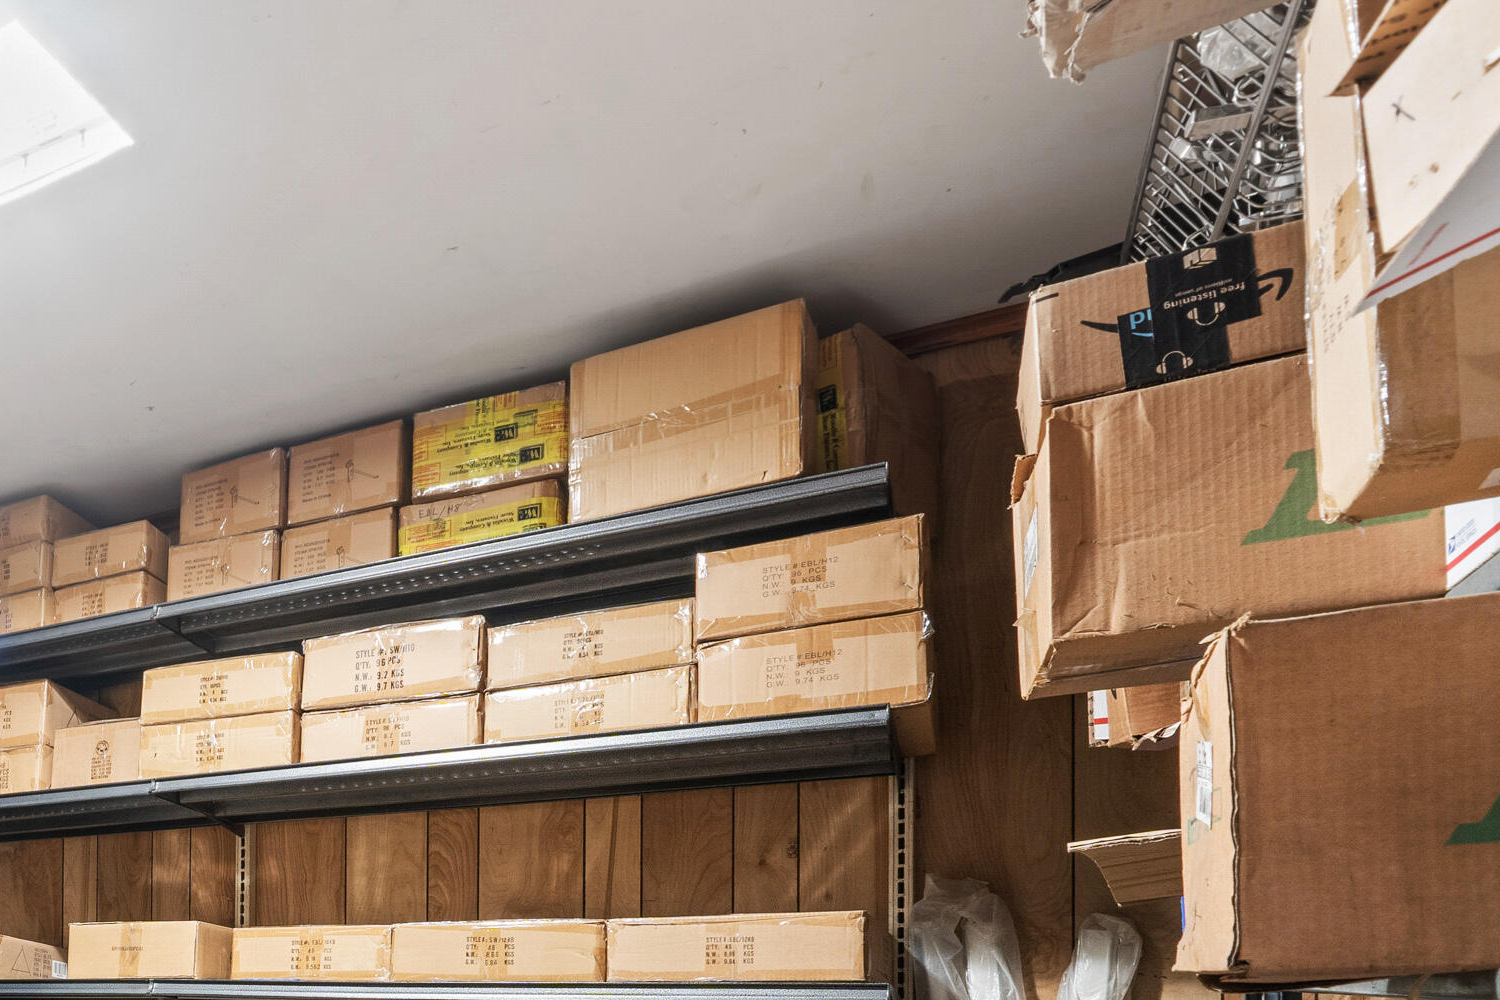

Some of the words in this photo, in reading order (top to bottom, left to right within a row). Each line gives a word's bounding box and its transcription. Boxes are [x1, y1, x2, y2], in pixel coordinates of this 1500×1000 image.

[1220, 281, 1246, 295] free
[1163, 290, 1216, 310] listening
[802, 575, 822, 583] KGS
[355, 649, 375, 659] STYLE
[391, 669, 404, 677] KGS
[806, 668, 826, 676] KGS
[819, 673, 840, 681] KGS
[390, 681, 404, 690] KGS
